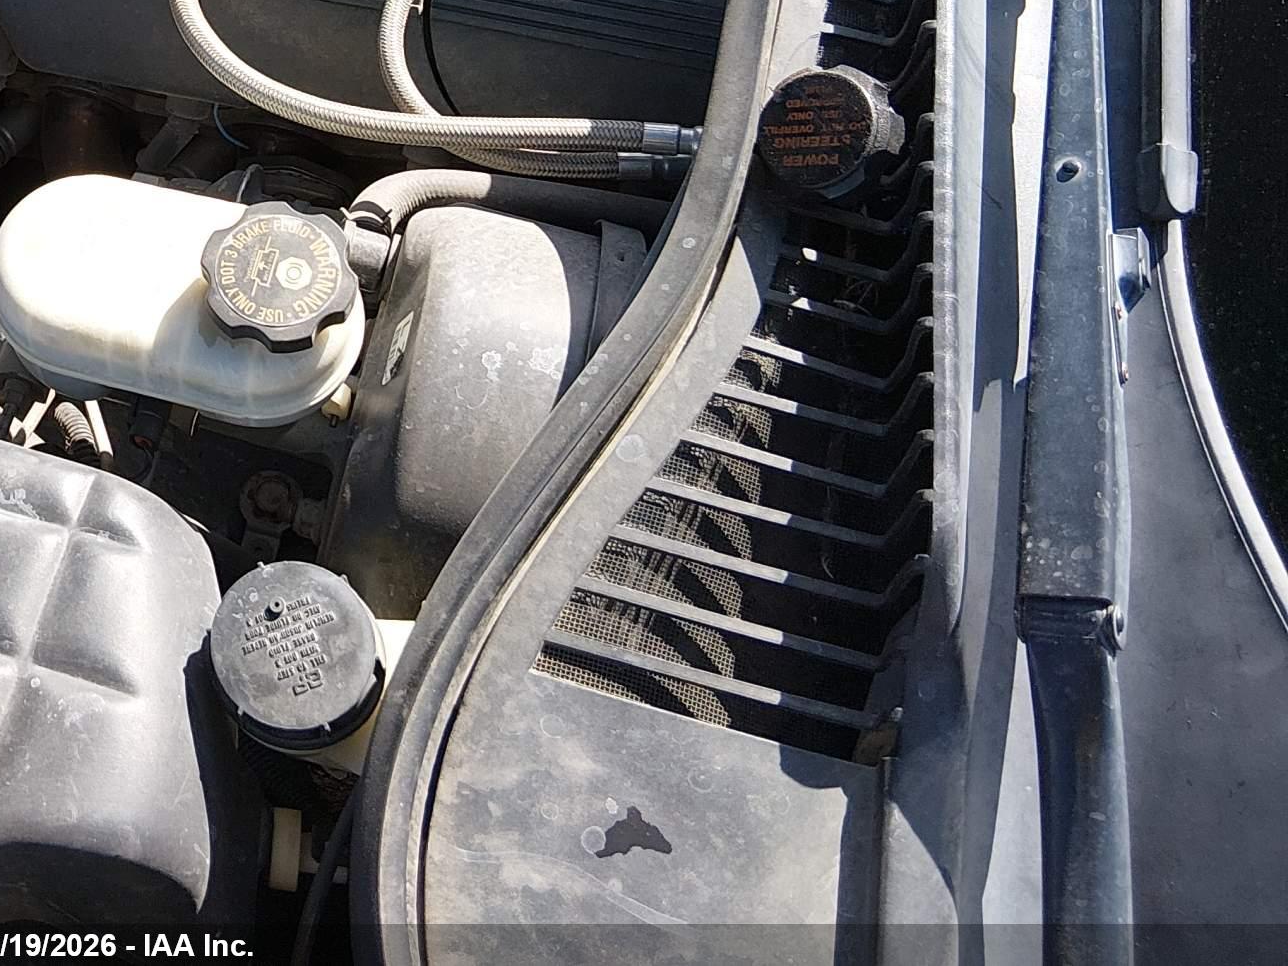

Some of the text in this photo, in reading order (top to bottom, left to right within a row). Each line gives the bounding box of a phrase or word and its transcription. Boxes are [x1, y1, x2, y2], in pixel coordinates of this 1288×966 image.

[786, 111, 814, 121] ONLY
[774, 135, 851, 149] STEERING
[783, 153, 839, 167] POWER
[232, 220, 270, 250] BRAKE
[272, 219, 312, 237] FLUID
[225, 249, 238, 258] 3
[220, 260, 236, 285] DOT
[293, 237, 337, 318] WARNING
[225, 287, 256, 314] ONLY
[256, 306, 284, 322] USE
